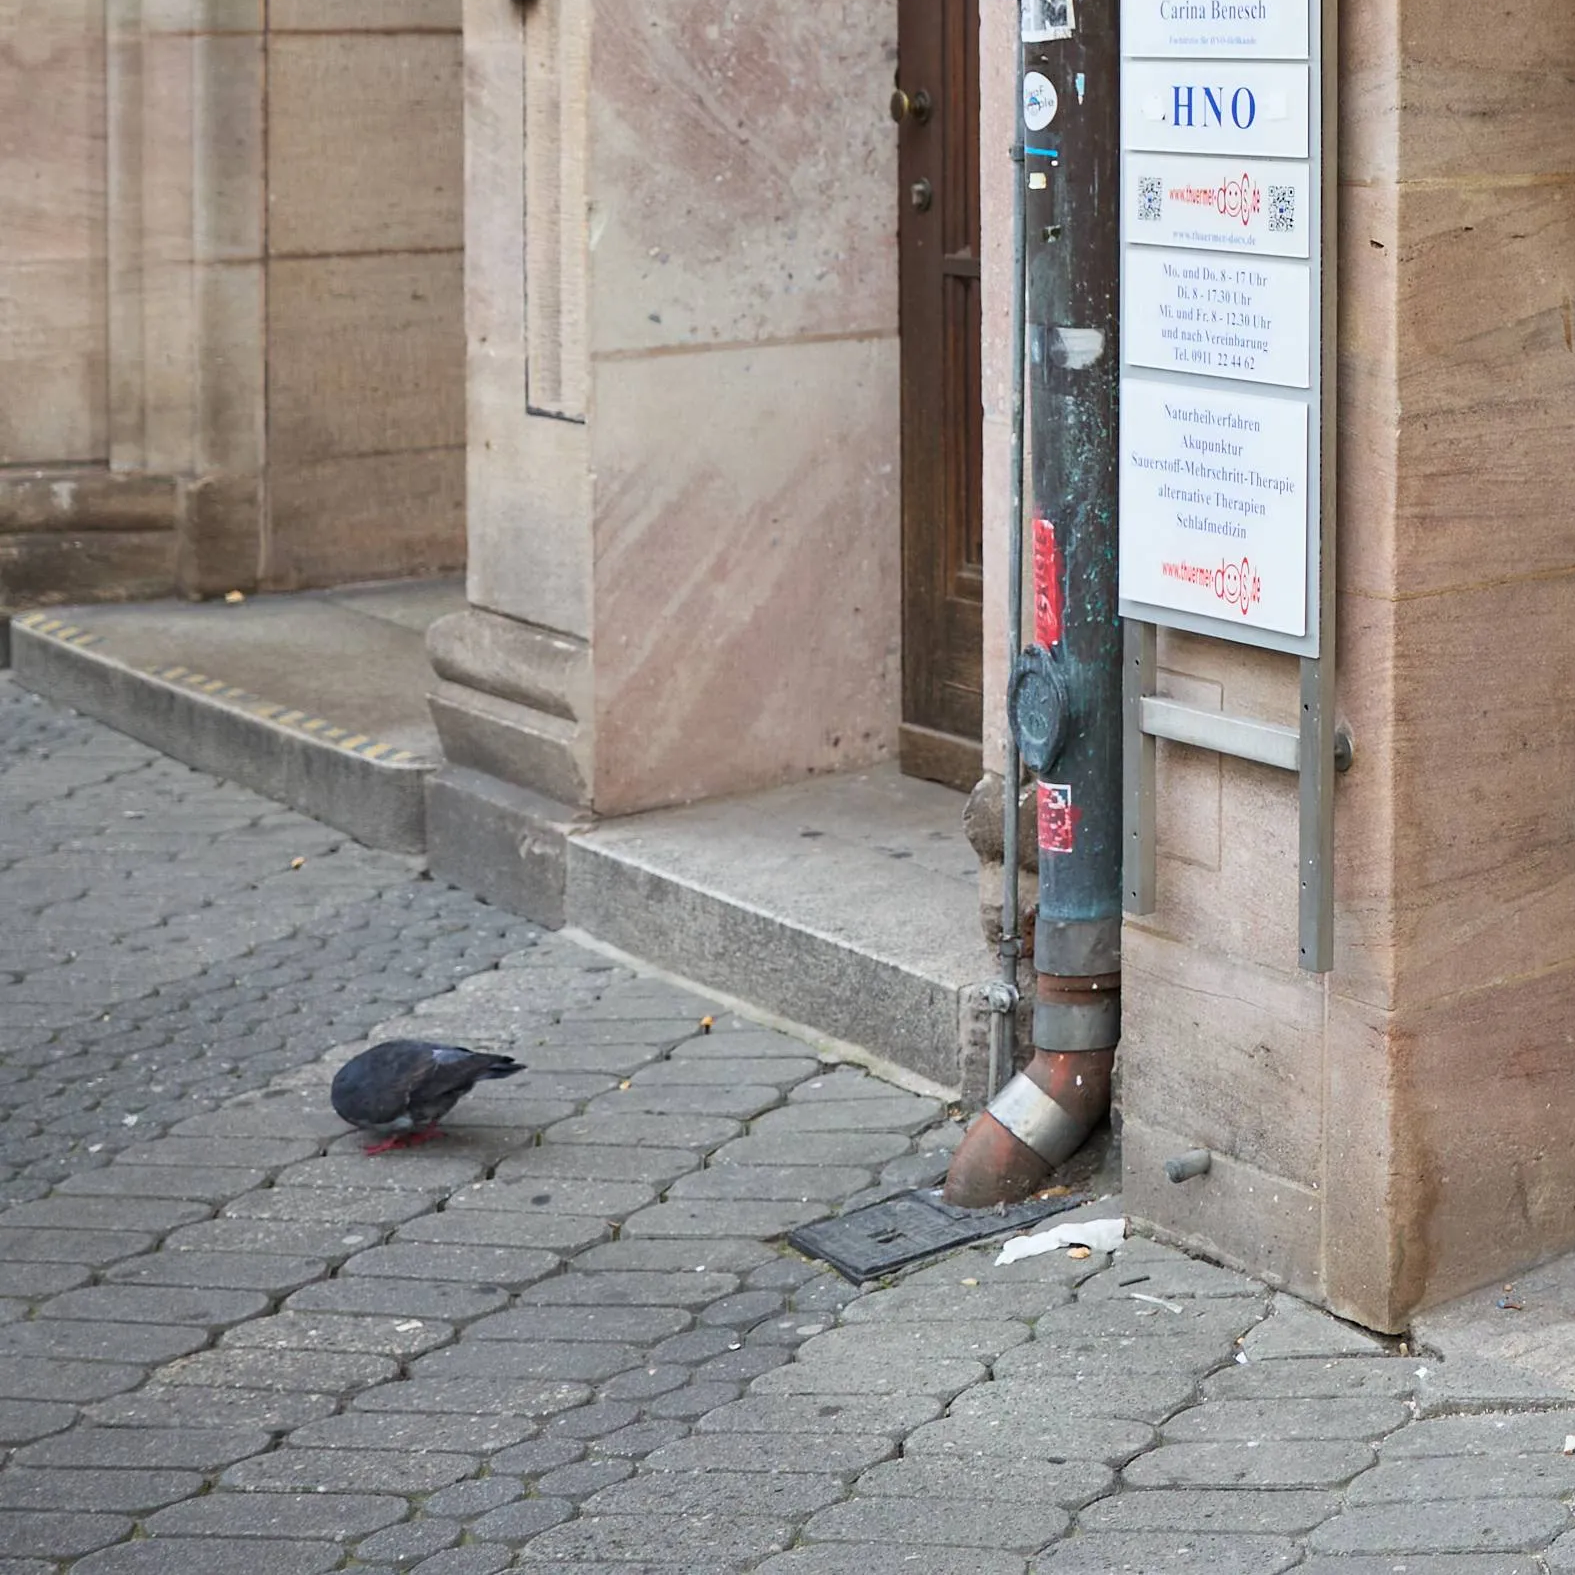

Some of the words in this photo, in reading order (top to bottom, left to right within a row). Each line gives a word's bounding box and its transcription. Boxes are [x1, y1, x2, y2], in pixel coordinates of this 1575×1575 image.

[1160, 0, 1206, 20] Carina
[1211, 0, 1266, 19] Benesch
[1172, 86, 1256, 129] HNO
[1163, 263, 1178, 277] Mo.
[1183, 266, 1199, 280] und
[1235, 271, 1246, 284] 17
[1249, 272, 1267, 287] Uhr
[1233, 291, 1252, 306] Uhr
[1176, 307, 1193, 321] und
[1253, 315, 1272, 330] Uhr
[1162, 327, 1178, 339] und
[1181, 329, 1202, 343] nach
[1205, 331, 1268, 353] Vereinbarung
[1191, 349, 1211, 365] 0911
[1218, 353, 1228, 367] 22
[1231, 354, 1241, 368] 44
[1244, 356, 1255, 370] 62
[1165, 404, 1260, 432] Naturheilverfahren
[1181, 435, 1243, 457] Akupunktur
[1131, 452, 1294, 495] Sauerstoff-Mehrschritt-Therapie
[1158, 485, 1211, 506] alternative
[1215, 492, 1266, 516] Therapien
[1176, 513, 1246, 539] Schlafmedizin
